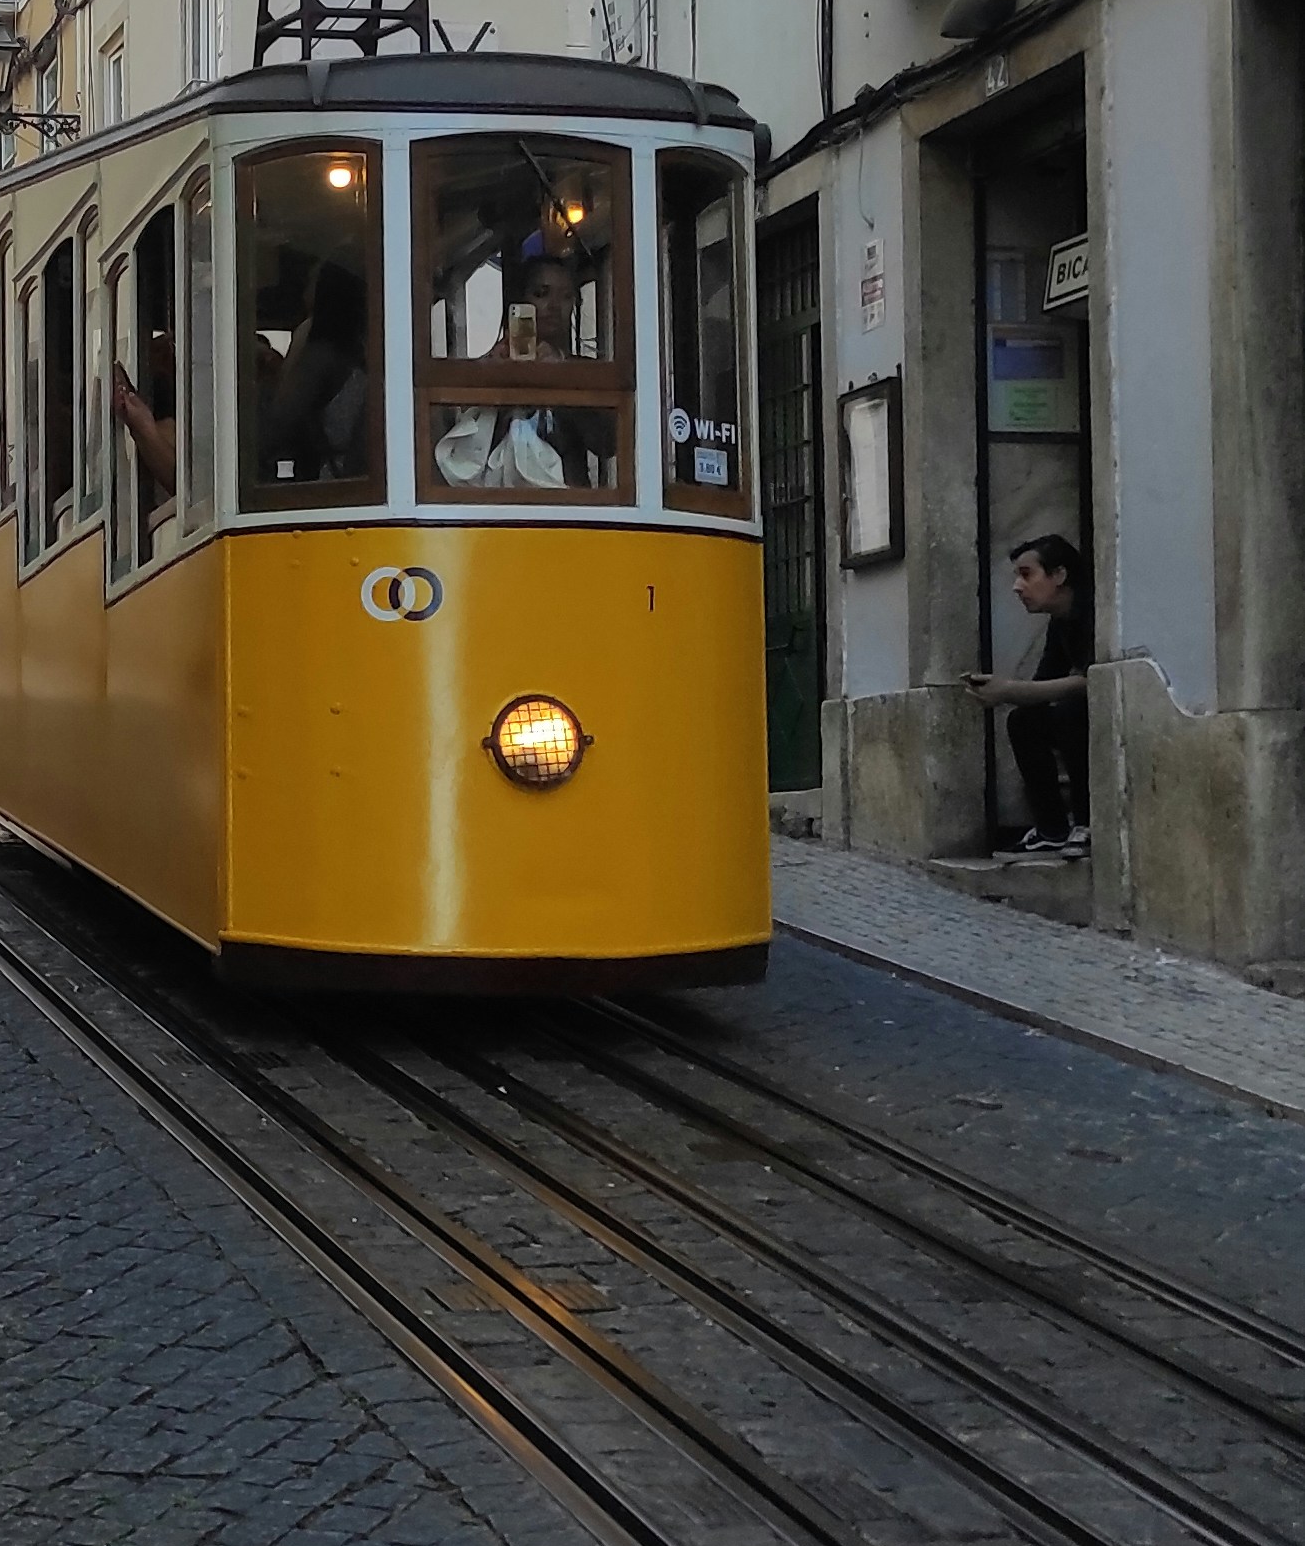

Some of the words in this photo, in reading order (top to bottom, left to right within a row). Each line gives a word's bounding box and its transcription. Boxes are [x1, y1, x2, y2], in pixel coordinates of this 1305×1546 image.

[987, 53, 1005, 89] 42
[694, 418, 736, 445] WI-FI
[645, 584, 655, 613] 1
